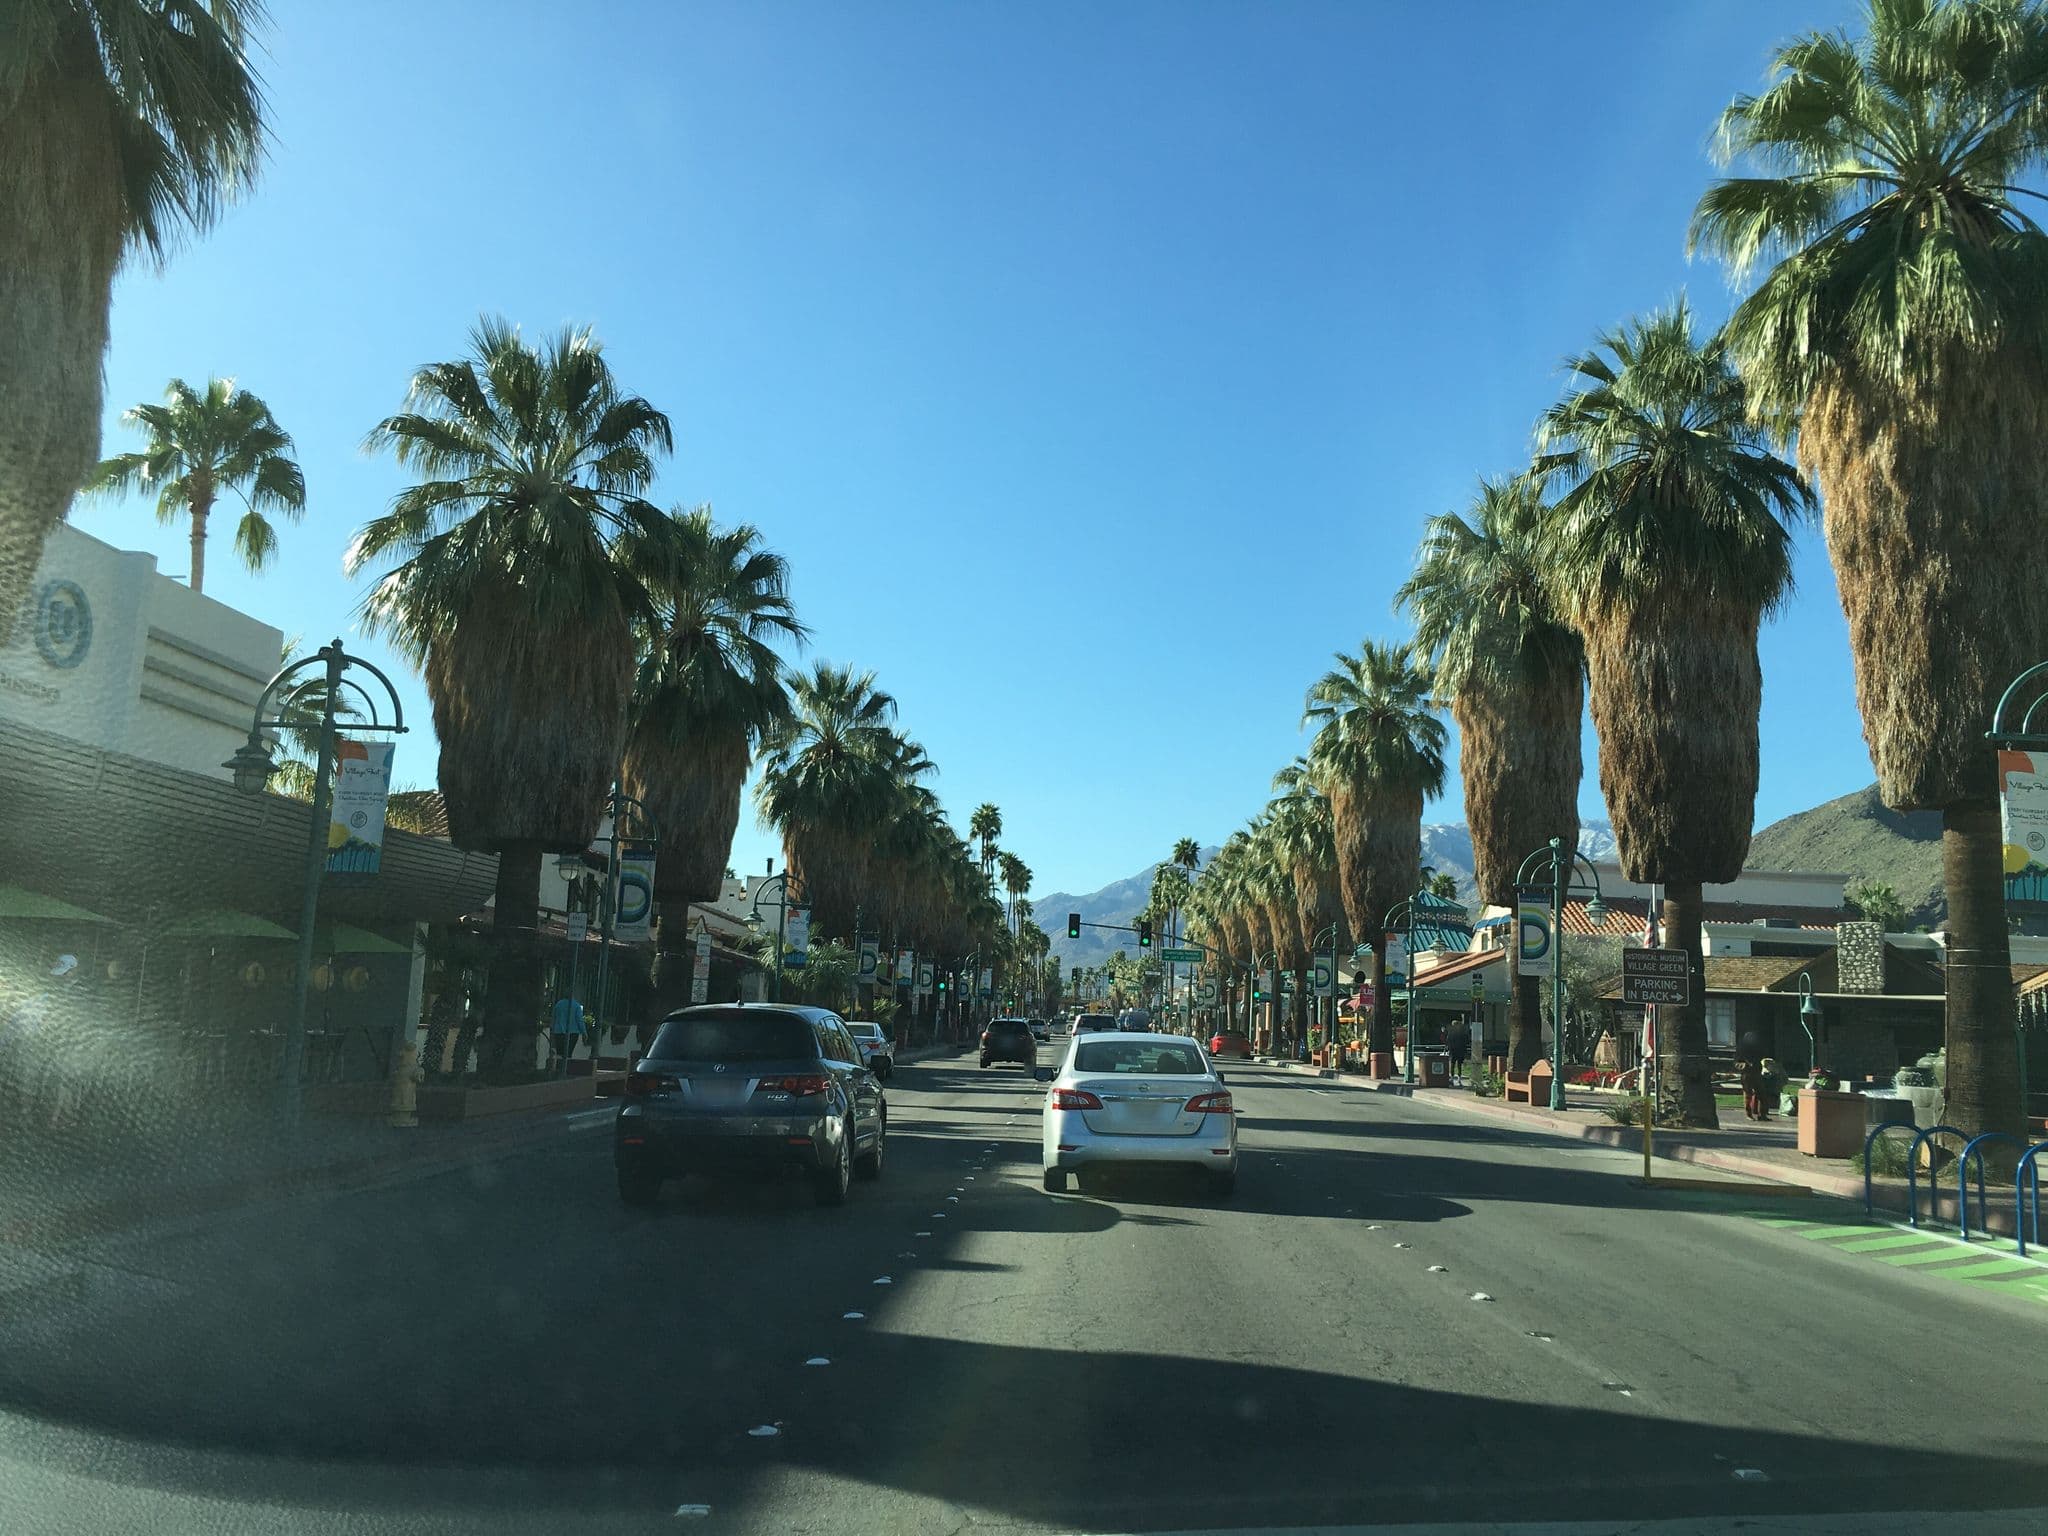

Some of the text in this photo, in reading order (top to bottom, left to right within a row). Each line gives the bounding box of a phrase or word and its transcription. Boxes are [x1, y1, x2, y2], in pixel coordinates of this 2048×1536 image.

[1520, 907, 1551, 960] D
[1624, 952, 1686, 962] HISTORICAL MUSEUM
[1626, 961, 1684, 973] VILLAGE GREEN
[1634, 978, 1678, 990] PARKING
[1627, 990, 1669, 1001] IN BACK
